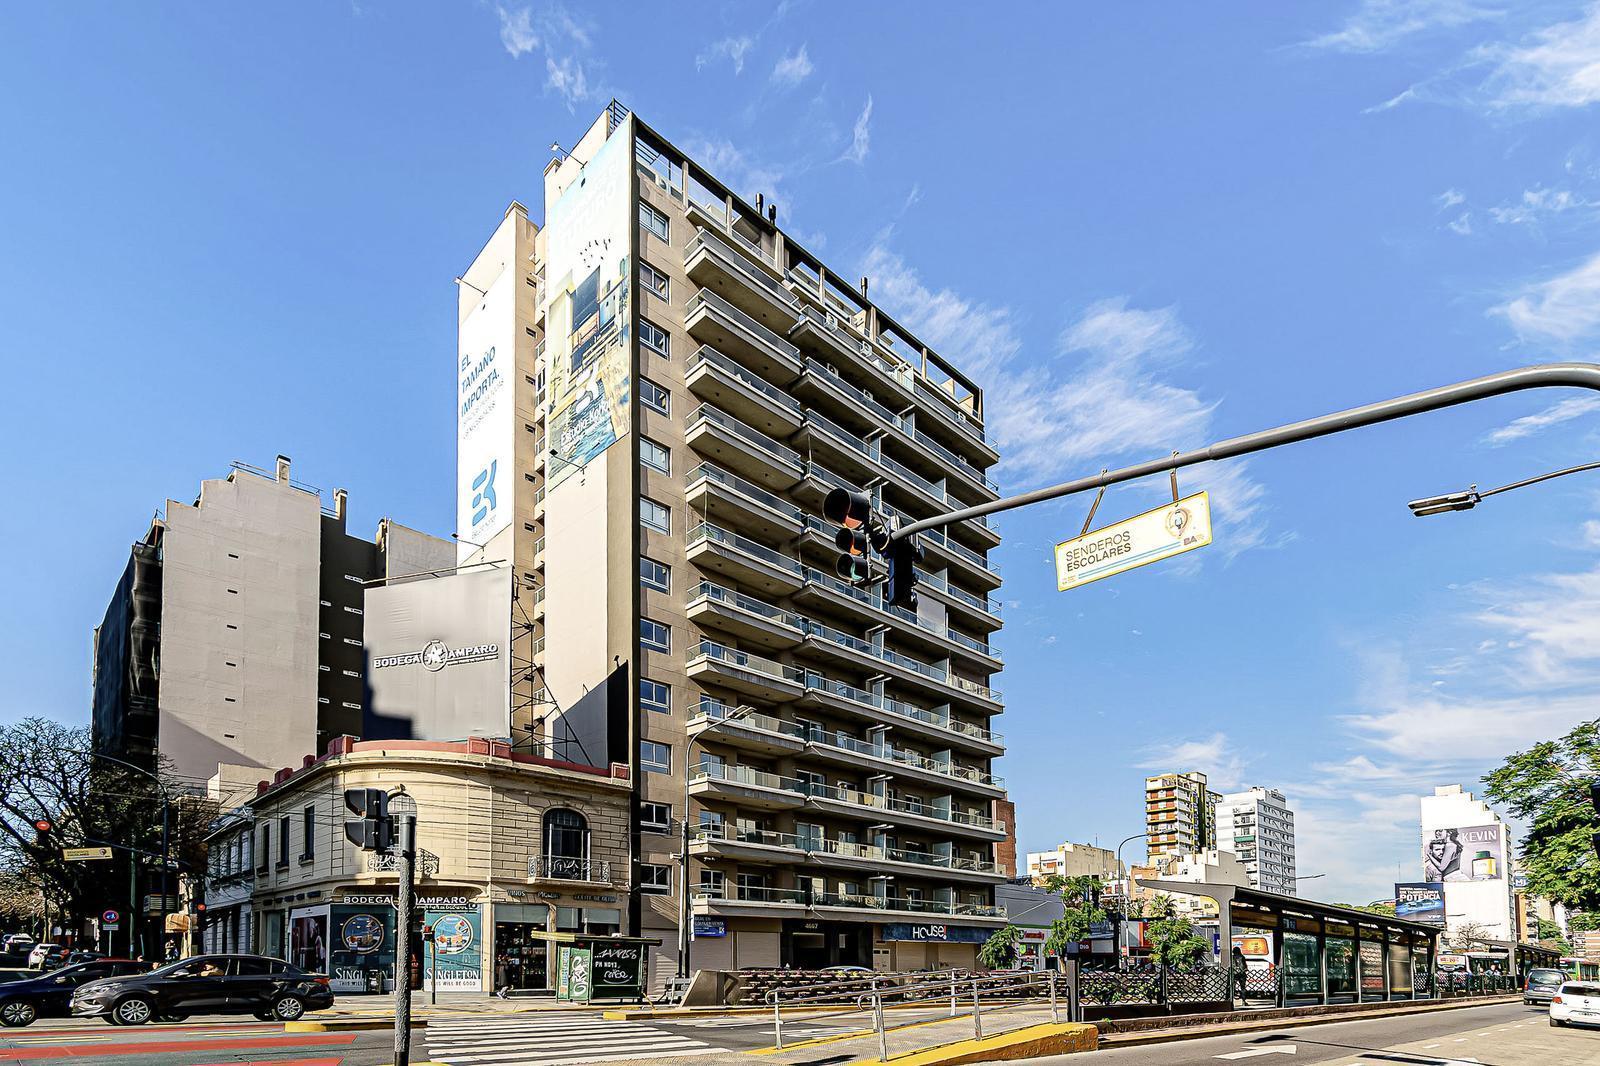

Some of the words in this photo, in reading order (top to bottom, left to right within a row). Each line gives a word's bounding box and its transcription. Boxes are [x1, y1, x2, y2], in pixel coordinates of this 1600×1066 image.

[461, 354, 471, 373] EL
[1065, 531, 1131, 562] SENDEROS
[1066, 543, 1132, 572] ESCOLARES
[373, 654, 422, 669] BODEGA
[447, 643, 499, 659] AMPARO
[1462, 830, 1497, 842] KEVIN
[343, 896, 392, 904] BODEGA
[418, 896, 467, 904] AMPARO
[1399, 892, 1441, 902] POTENCIA
